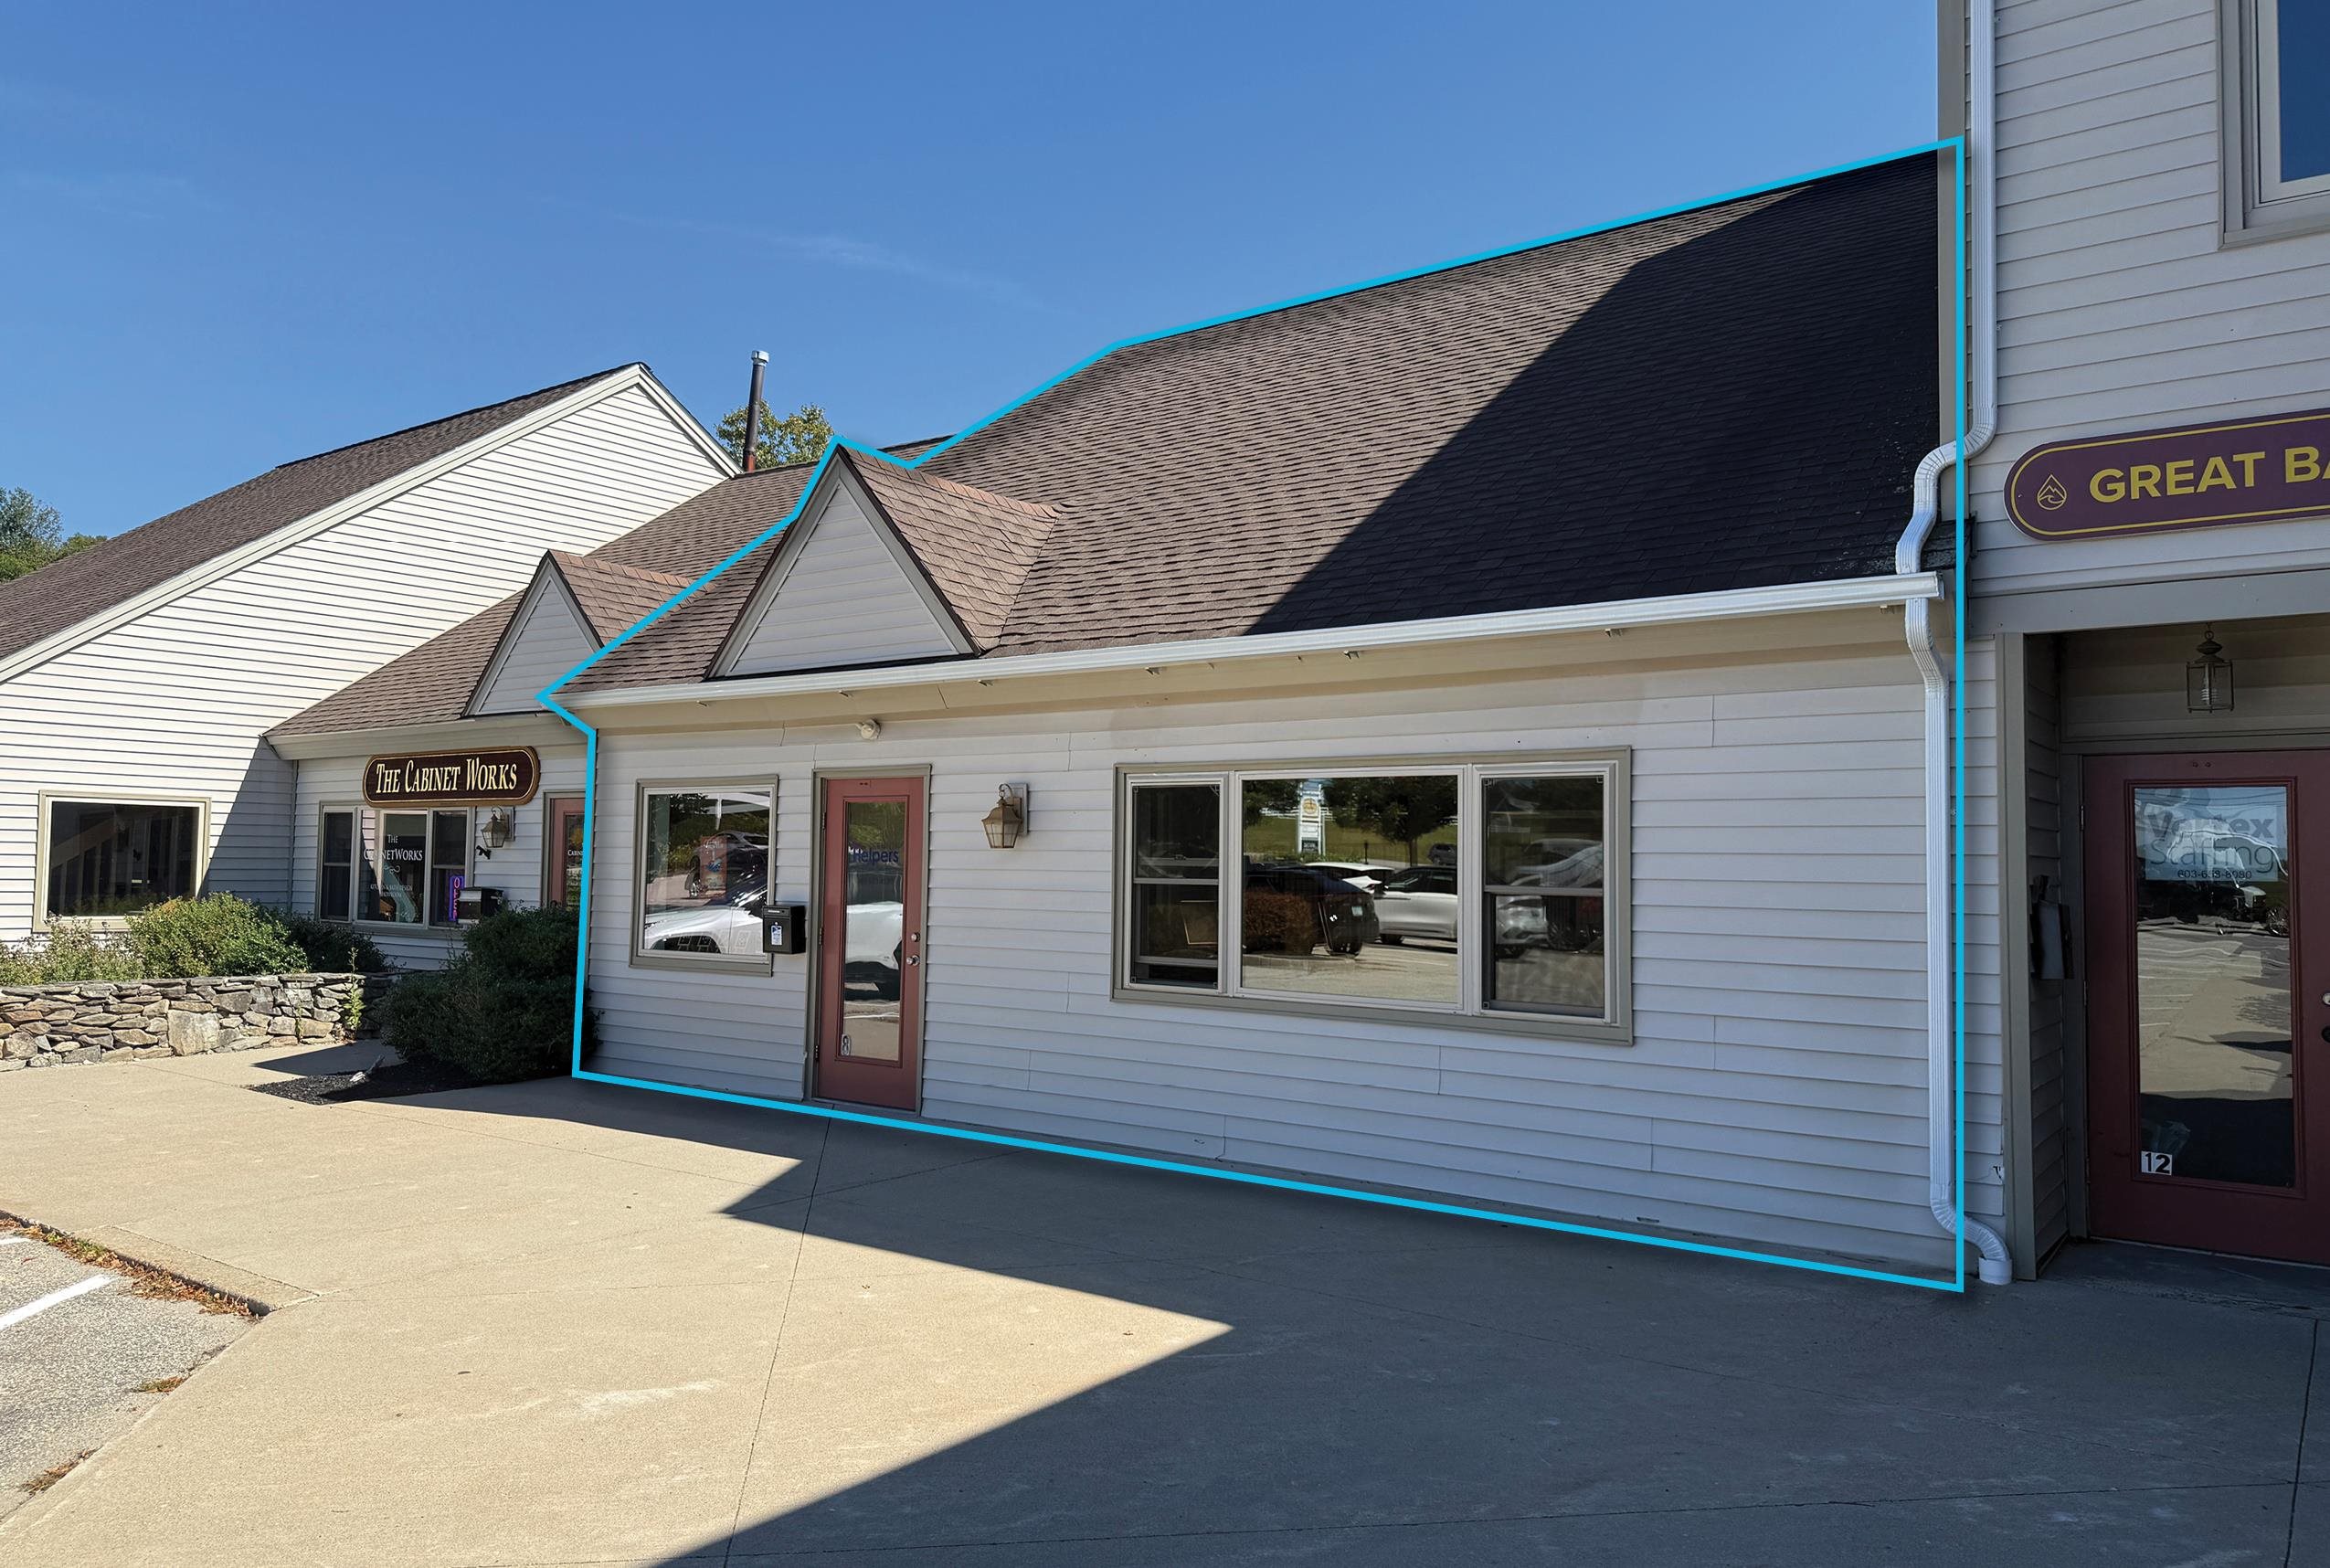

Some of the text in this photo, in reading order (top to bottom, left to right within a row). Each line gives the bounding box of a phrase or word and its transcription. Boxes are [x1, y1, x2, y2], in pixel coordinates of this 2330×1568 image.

[2090, 446, 2330, 503] GREAT B
[376, 757, 517, 793] THE CABINET WORKS
[387, 833, 398, 843] THE
[853, 848, 899, 866] Helpers
[2145, 1152, 2171, 1174] 12
